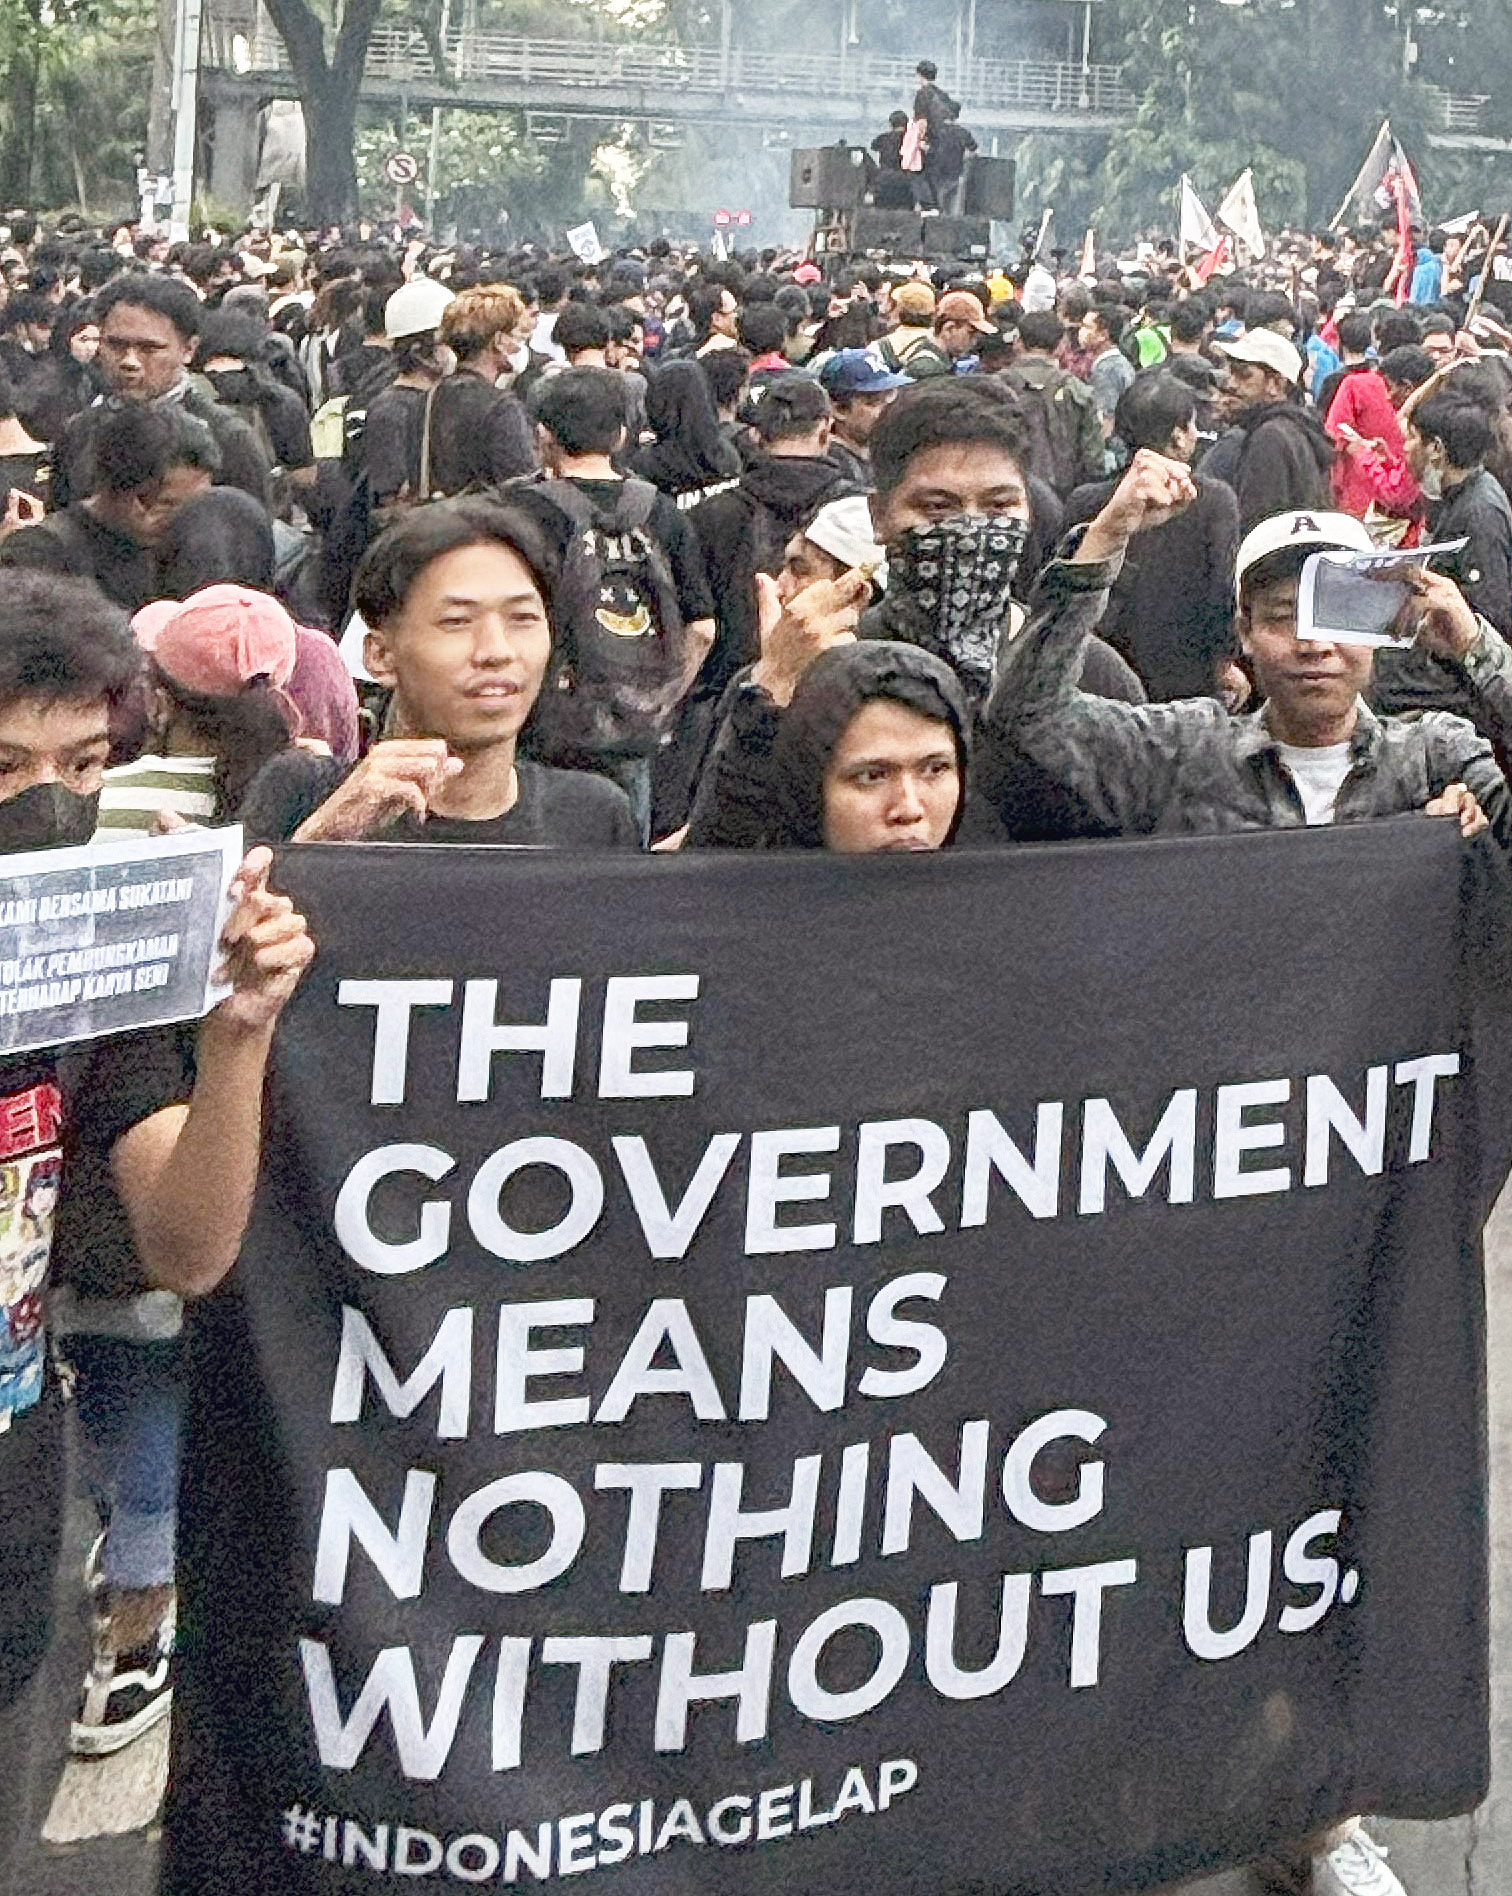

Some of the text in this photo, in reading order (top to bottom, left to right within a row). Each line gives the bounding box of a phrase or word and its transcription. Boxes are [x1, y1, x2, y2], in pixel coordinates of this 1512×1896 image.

[1291, 515, 1321, 535] A
[337, 974, 700, 1106] THE
[334, 1052, 1461, 1276] GOVERNMENT
[330, 1271, 949, 1439] MEANS
[312, 1408, 1109, 1606] NOTHING
[298, 1509, 1360, 1781] WITHOUT US.
[283, 1758, 919, 1883] #INDONESIAGELAP
